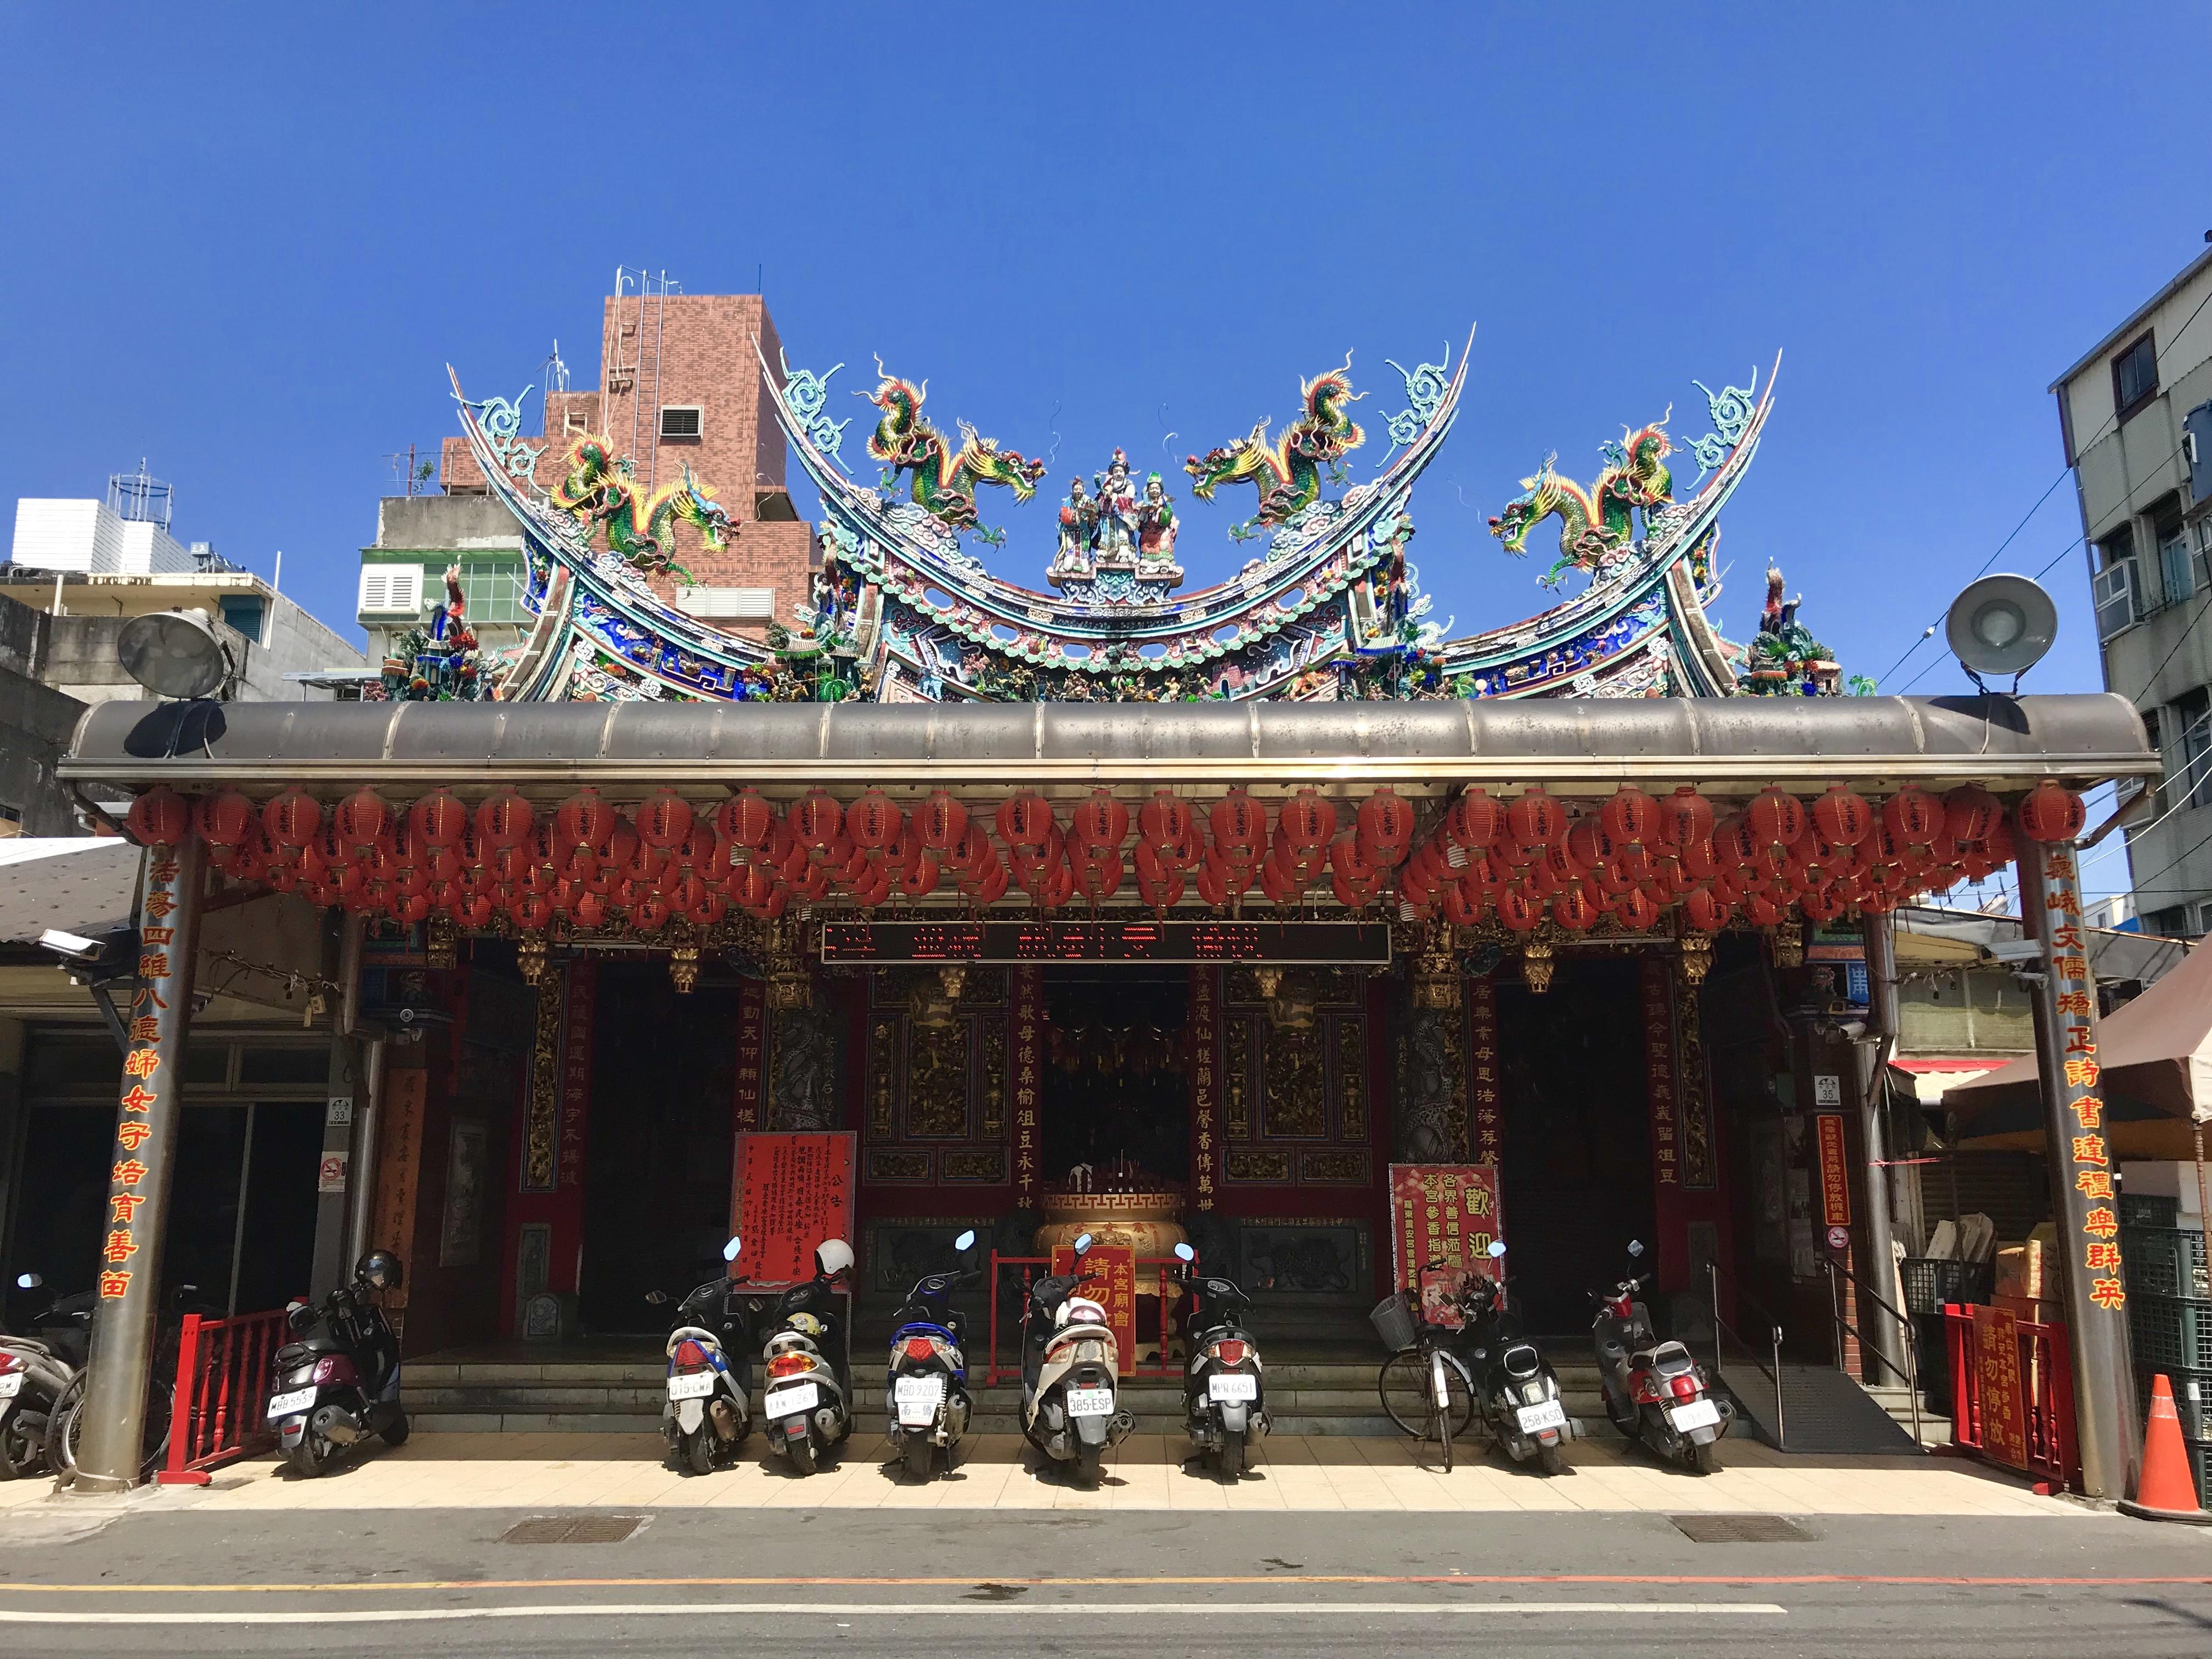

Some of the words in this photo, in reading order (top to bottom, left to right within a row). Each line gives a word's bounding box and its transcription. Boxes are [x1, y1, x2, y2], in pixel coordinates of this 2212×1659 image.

[736, 986, 761, 1132] 地動天仰賴仙槎
[1822, 1090, 1833, 1099] 35
[334, 1111, 345, 1120] 33
[830, 1175, 844, 1207] 公告
[1464, 1187, 1492, 1260] 歡迎
[1404, 1199, 1417, 1293] 羅東震安宮管理委員
[1983, 1324, 2006, 1446] 請勿停放
